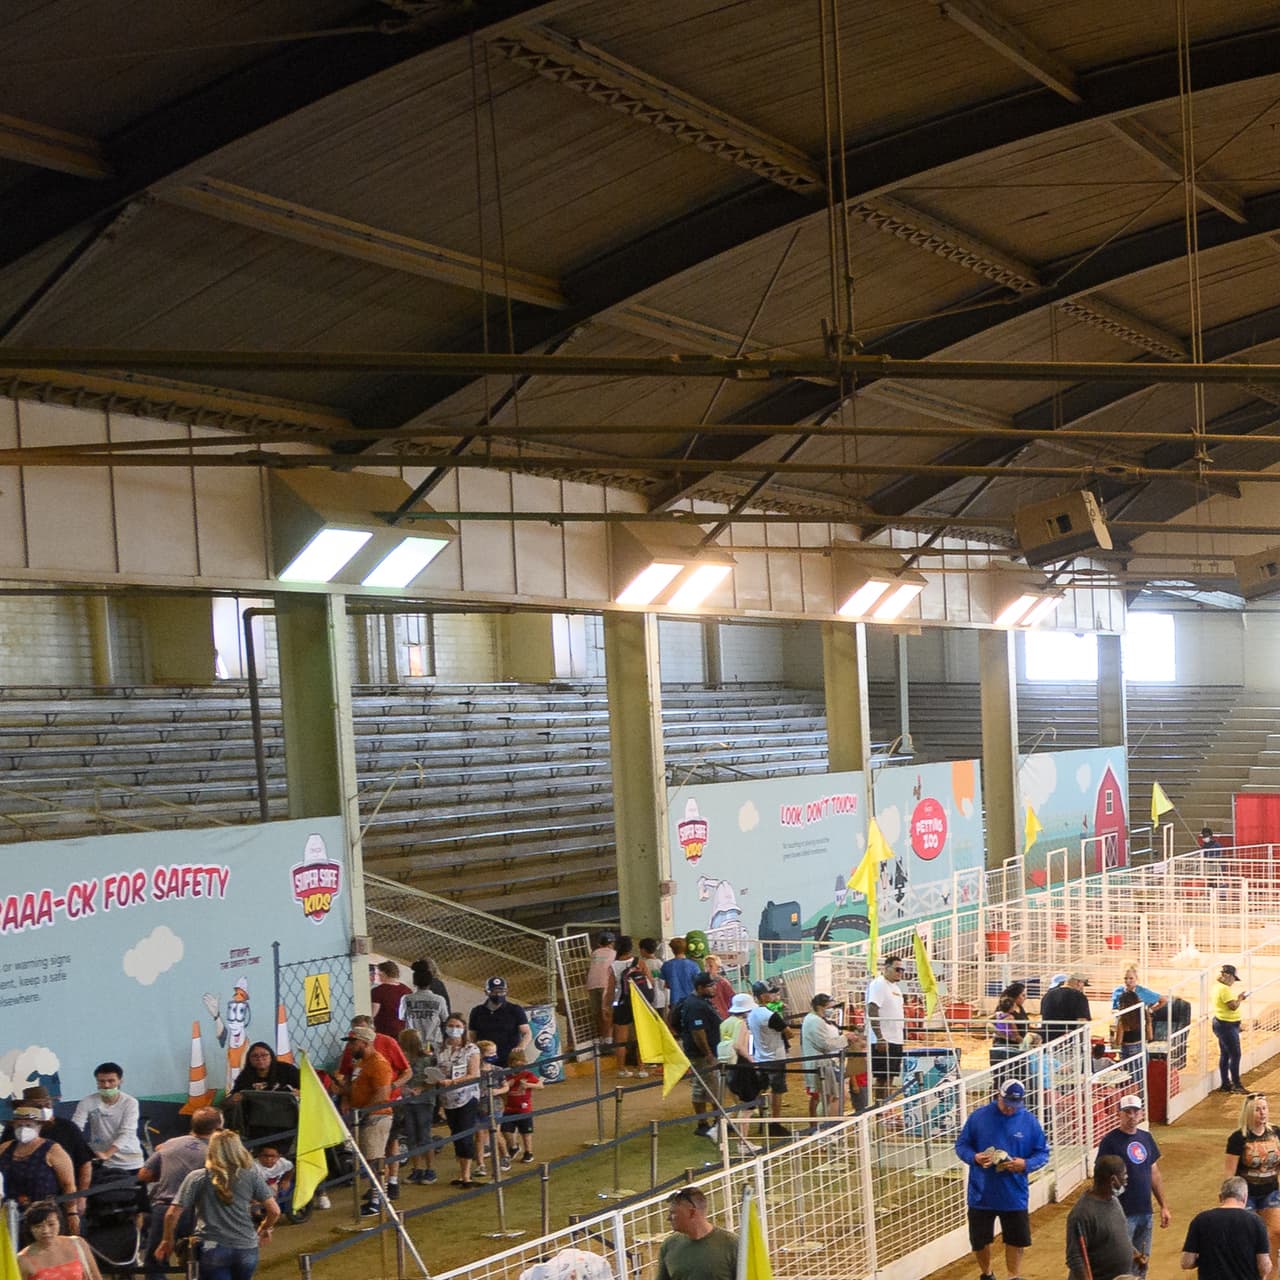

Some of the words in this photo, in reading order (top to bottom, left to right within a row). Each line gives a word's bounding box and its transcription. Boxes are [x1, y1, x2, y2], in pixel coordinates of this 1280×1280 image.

[780, 804, 804, 829] LOOK,
[807, 799, 830, 823] DON'T
[915, 818, 943, 835] PETTING
[923, 834, 938, 849] ZOO
[0, 881, 98, 932] AAA-CK
[104, 870, 146, 910] FOR
[152, 865, 230, 900] SAFETY
[303, 893, 331, 915] KIDS
